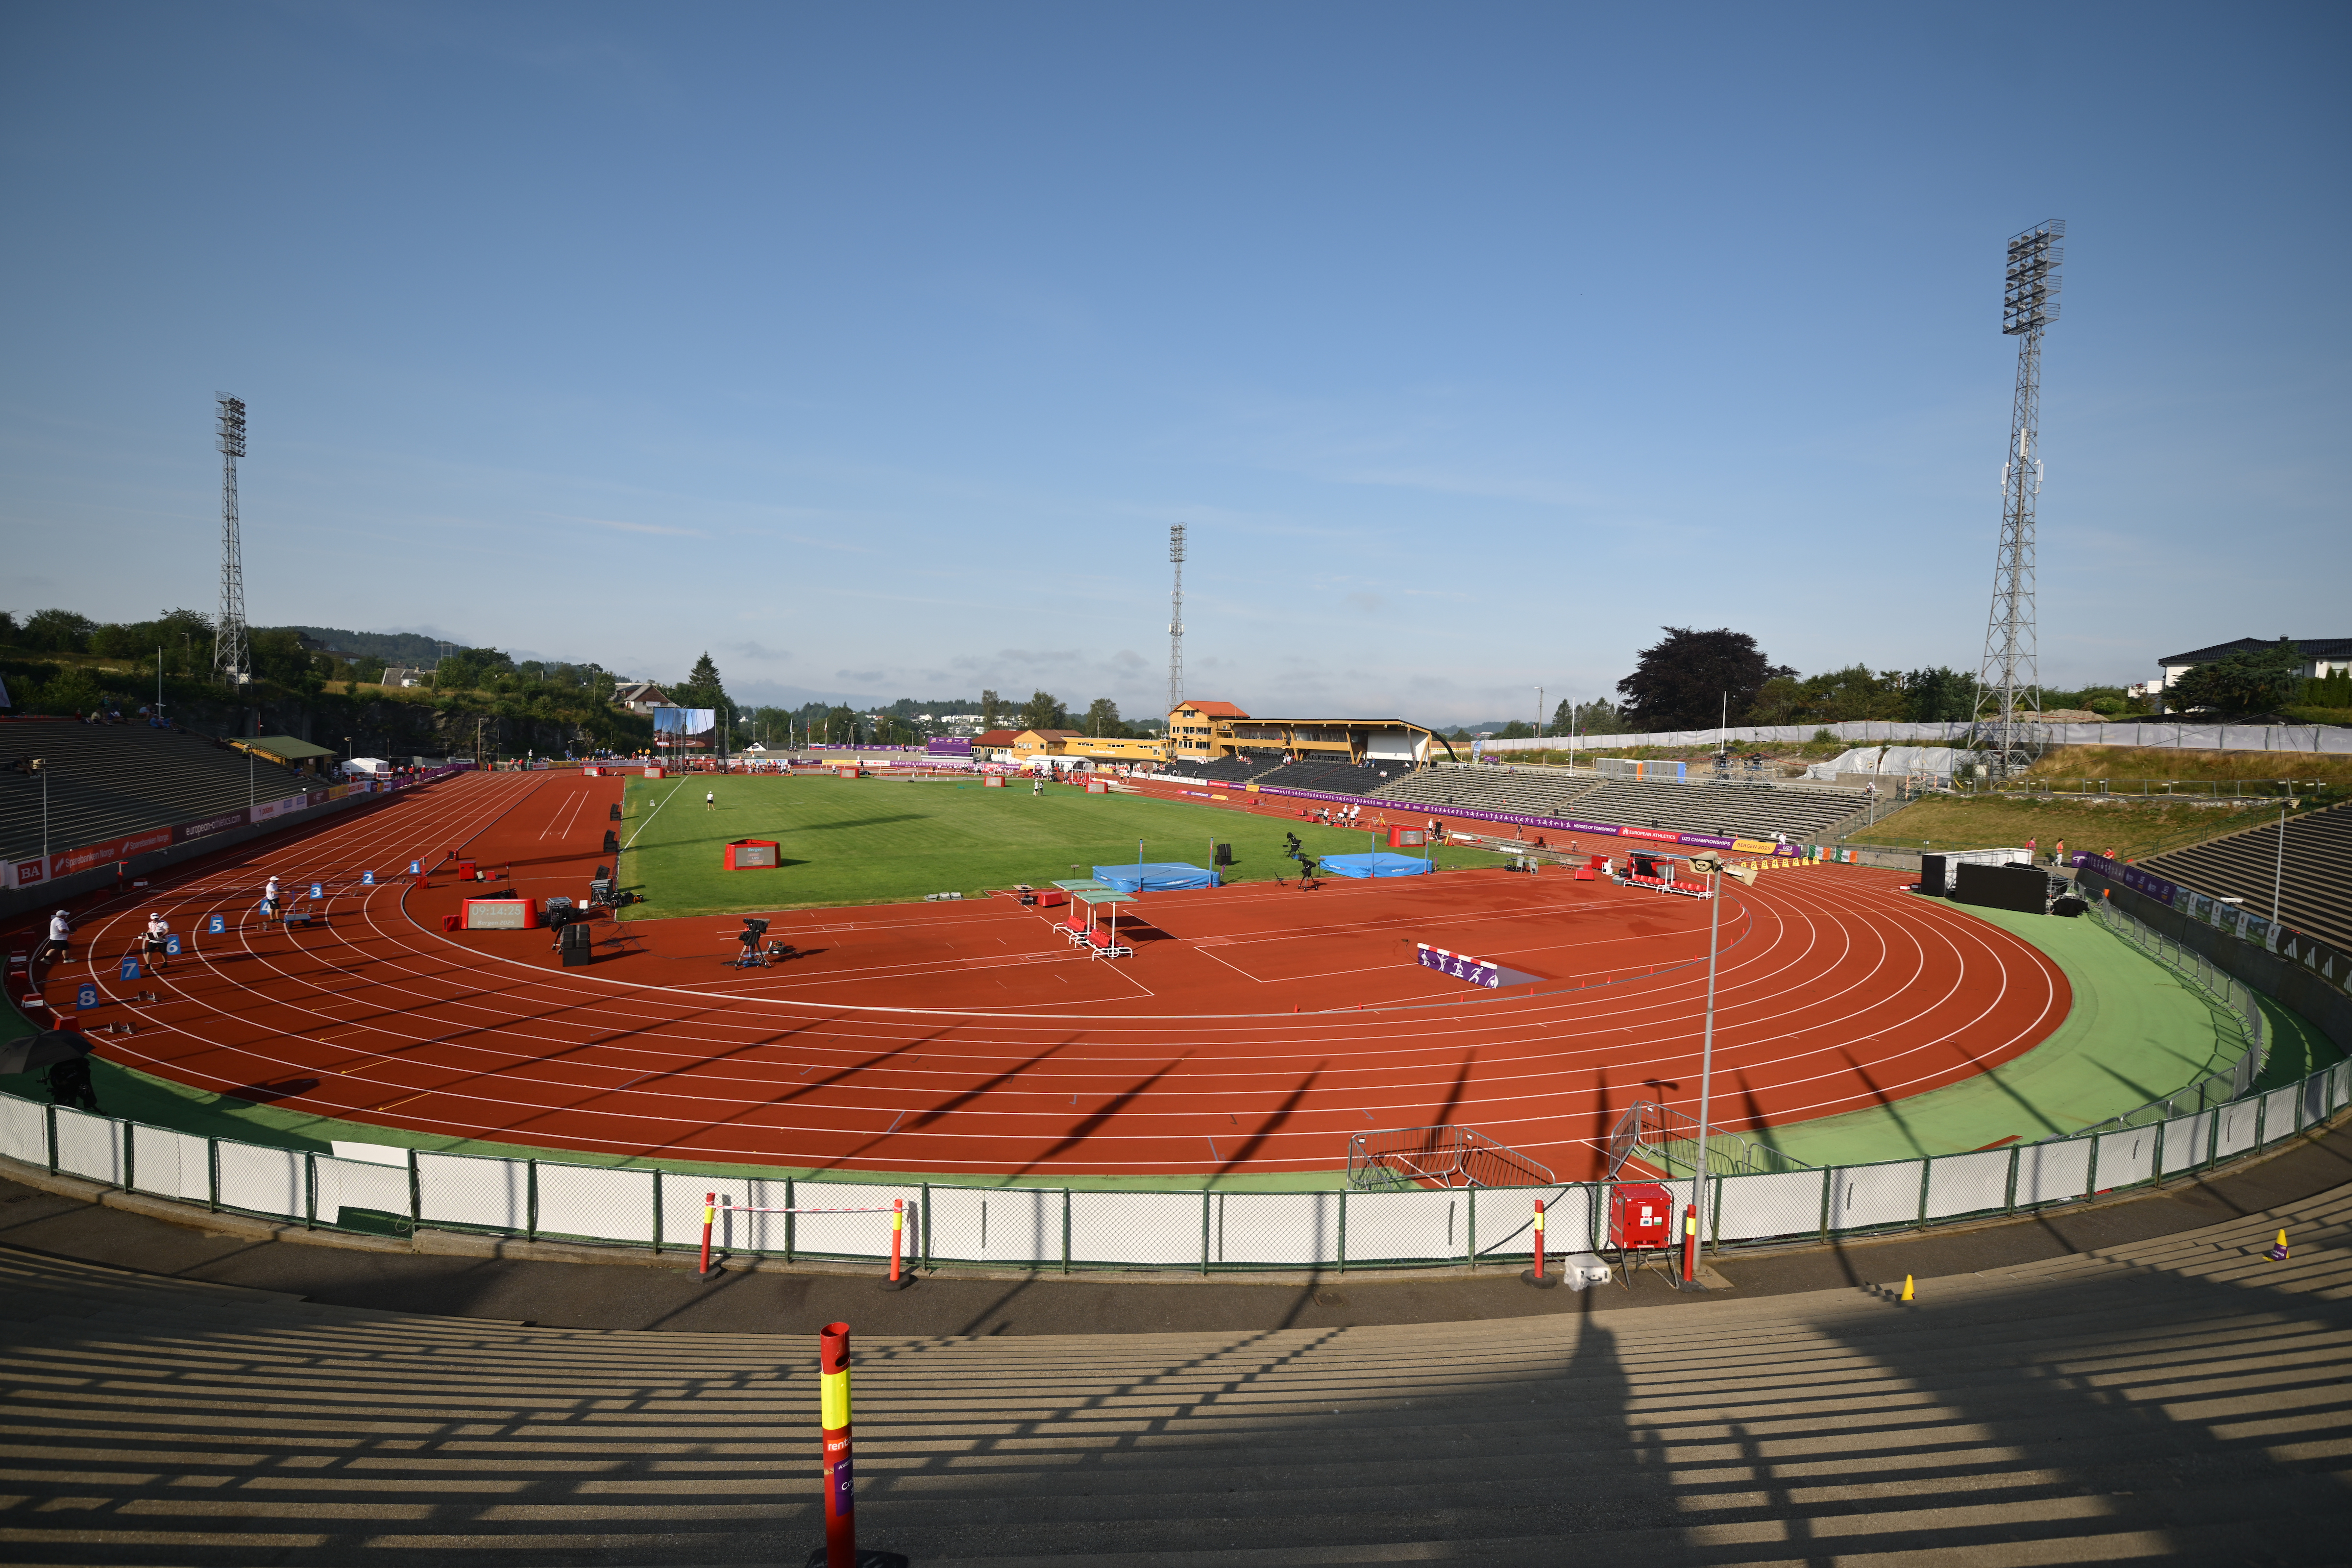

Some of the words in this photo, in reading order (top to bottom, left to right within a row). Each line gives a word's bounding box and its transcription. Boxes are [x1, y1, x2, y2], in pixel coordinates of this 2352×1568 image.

[262, 805, 274, 816] polanik
[186, 813, 241, 836] european-athletics.com
[129, 837, 156, 852] Sparebanken
[156, 834, 170, 844] Norge
[1691, 837, 1731, 846] CHAMPIONSHIPS
[65, 853, 99, 868] Sparebanken
[99, 848, 115, 858] Norge
[21, 865, 40, 880] BA
[412, 863, 418, 872] 1
[364, 874, 372, 883] 2
[312, 887, 320, 897] 3
[262, 902, 270, 913] 4
[472, 906, 521, 915] 09:14:25
[212, 920, 222, 932] 5
[166, 940, 178, 953] 6
[123, 963, 137, 978] 7
[79, 990, 96, 1005] 8
